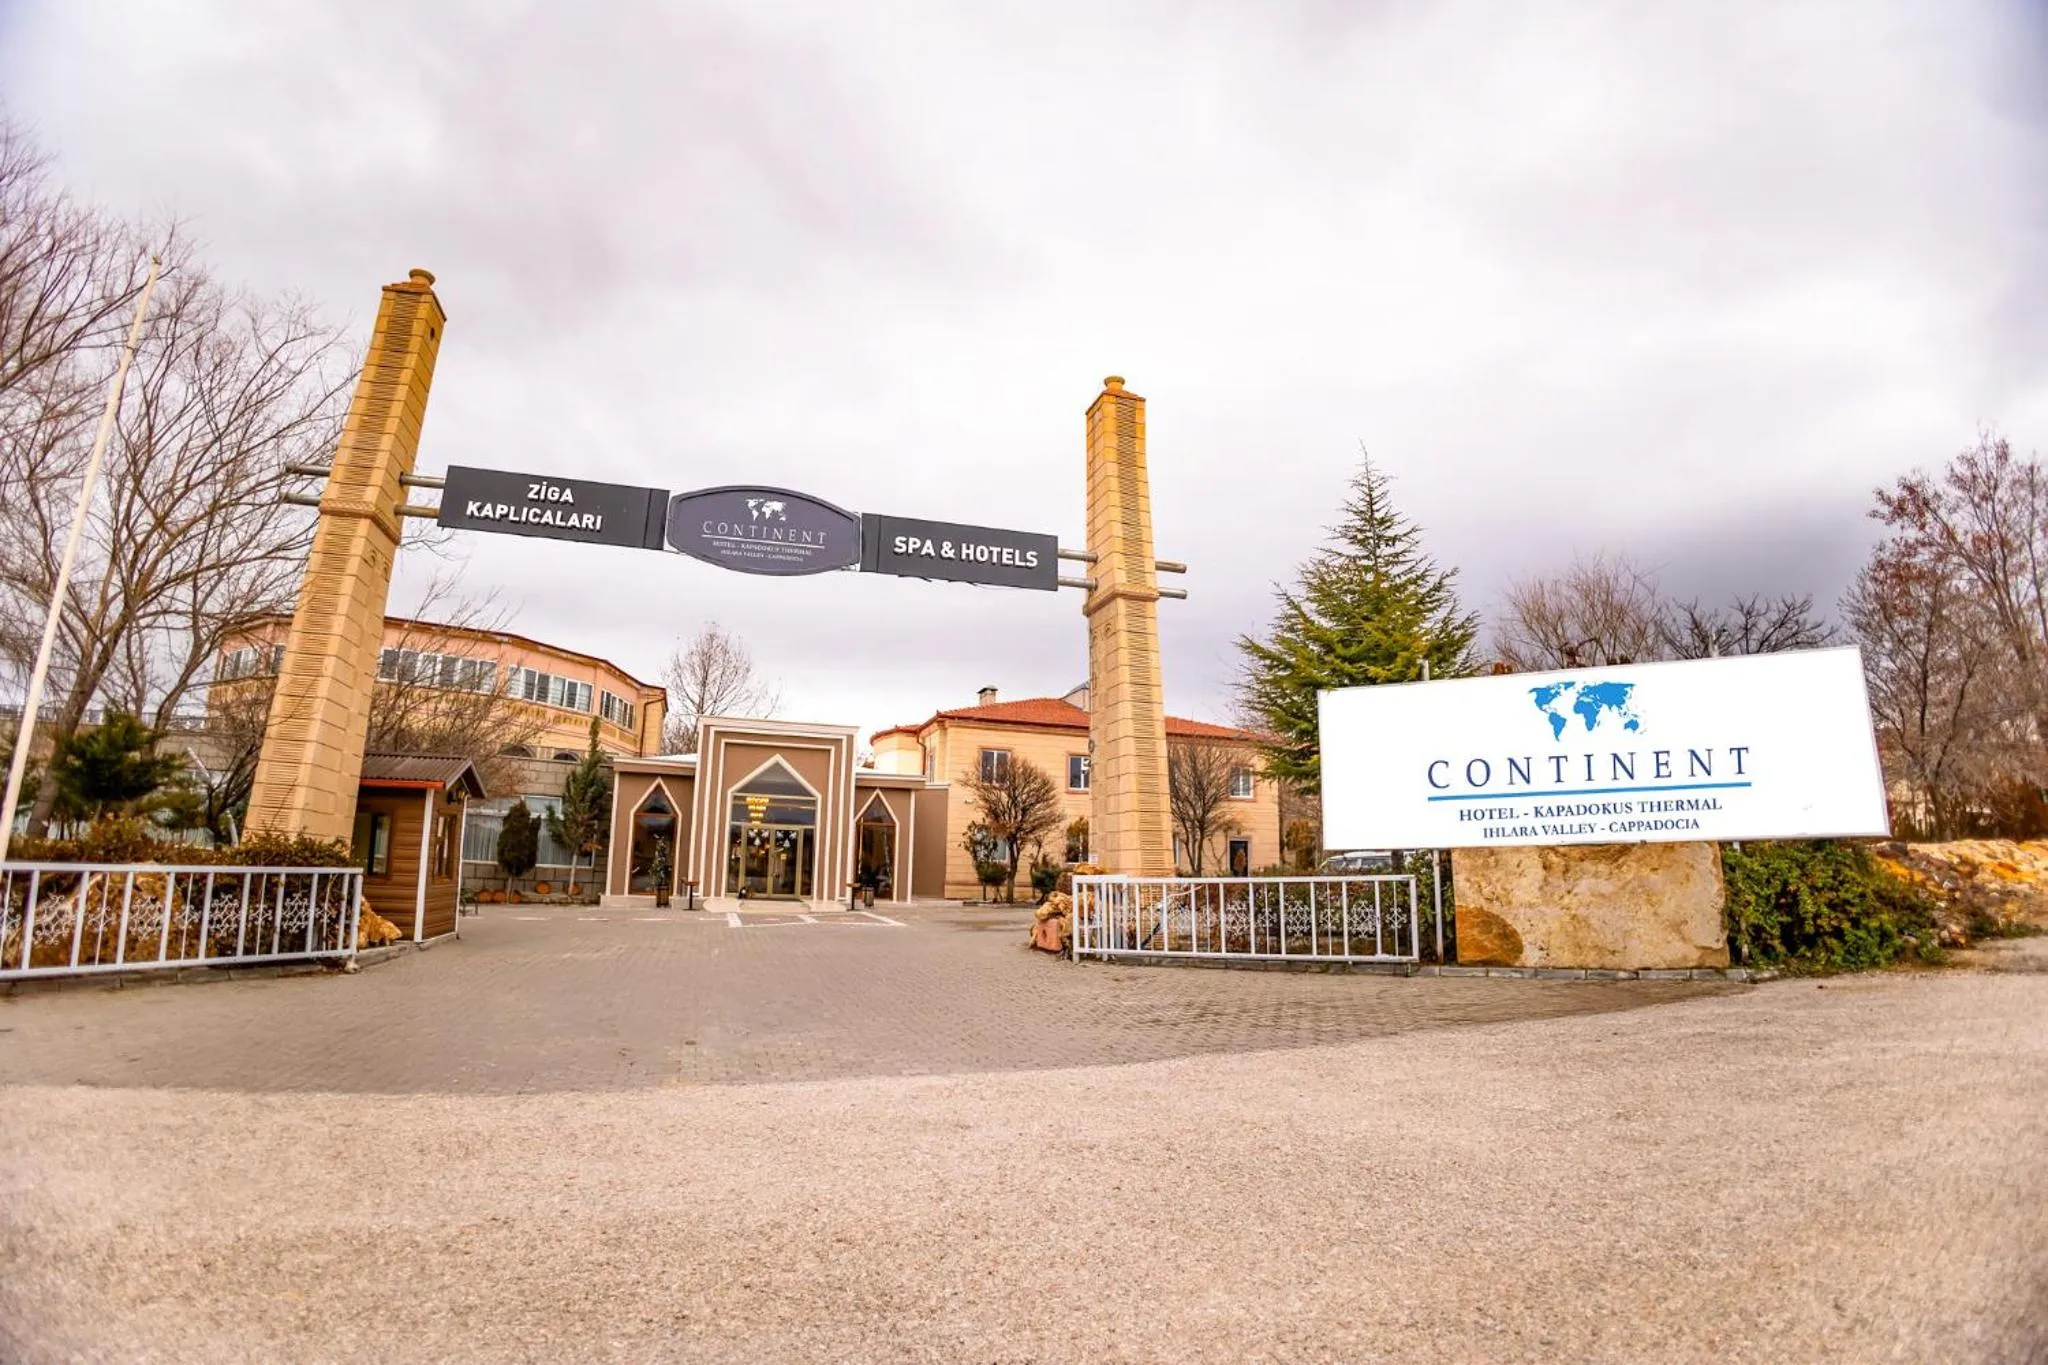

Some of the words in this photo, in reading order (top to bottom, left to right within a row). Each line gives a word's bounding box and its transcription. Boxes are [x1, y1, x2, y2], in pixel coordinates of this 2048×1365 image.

[528, 481, 574, 504] ZİGA
[466, 500, 602, 531] KAPLICALARI
[702, 521, 827, 545] CONTINENT
[894, 536, 936, 556] SPA
[940, 541, 956, 557] &
[961, 543, 1038, 568] HOTELS
[1427, 747, 1751, 790] CONTINENT
[1459, 805, 1520, 822] HOTEL
[1533, 801, 1634, 820] KAPADOKUS
[1637, 797, 1723, 814] THERMAL
[1483, 825, 1539, 839] IHLARA
[1541, 822, 1598, 836] VALLEY
[1609, 818, 1701, 834] CAPPADOCIA
